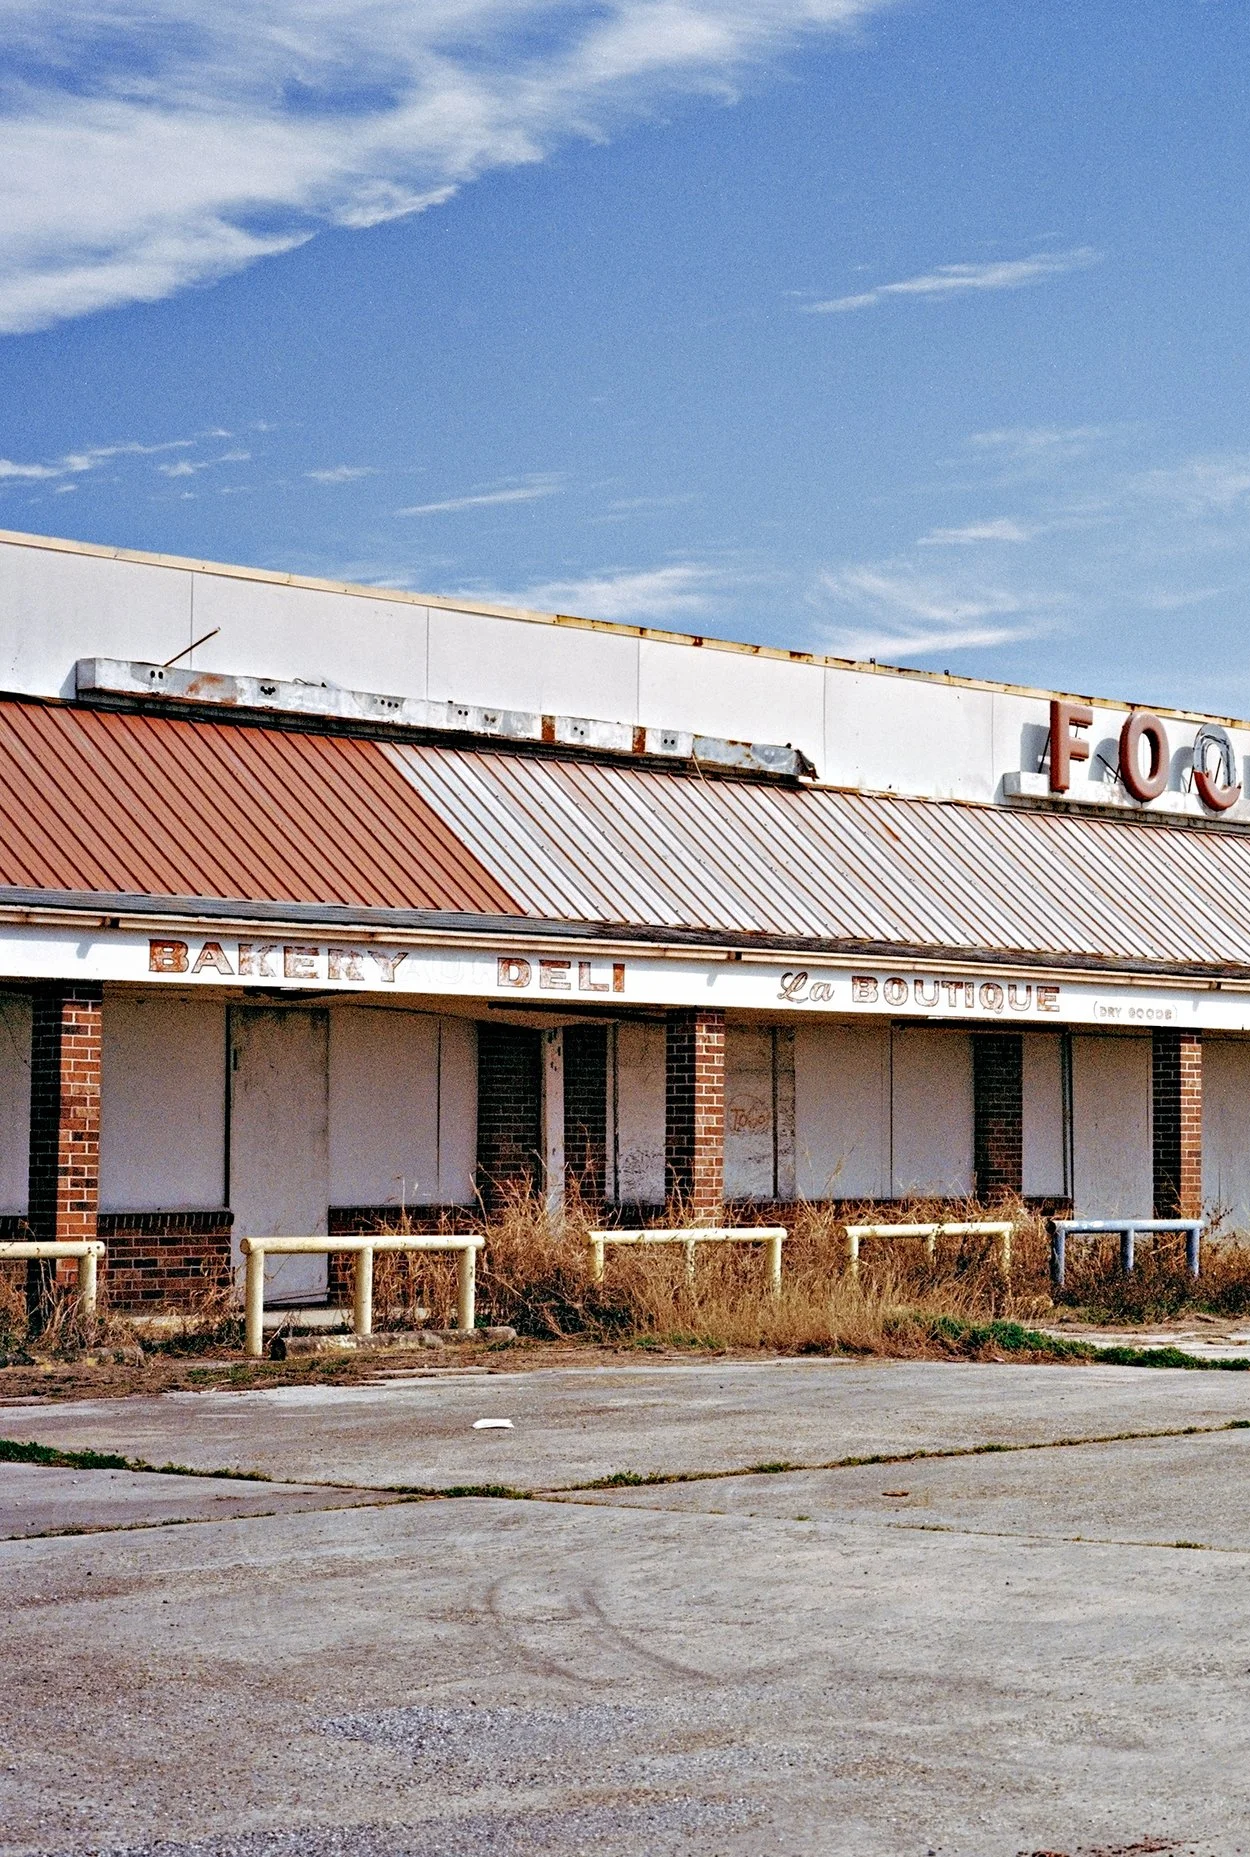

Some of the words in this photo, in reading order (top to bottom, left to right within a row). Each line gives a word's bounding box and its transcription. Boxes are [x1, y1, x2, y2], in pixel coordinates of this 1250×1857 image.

[148, 938, 409, 983] BAKERY
[497, 957, 626, 993] DELI
[776, 971, 835, 1003] La
[851, 975, 1061, 1014] BOUTIQUE
